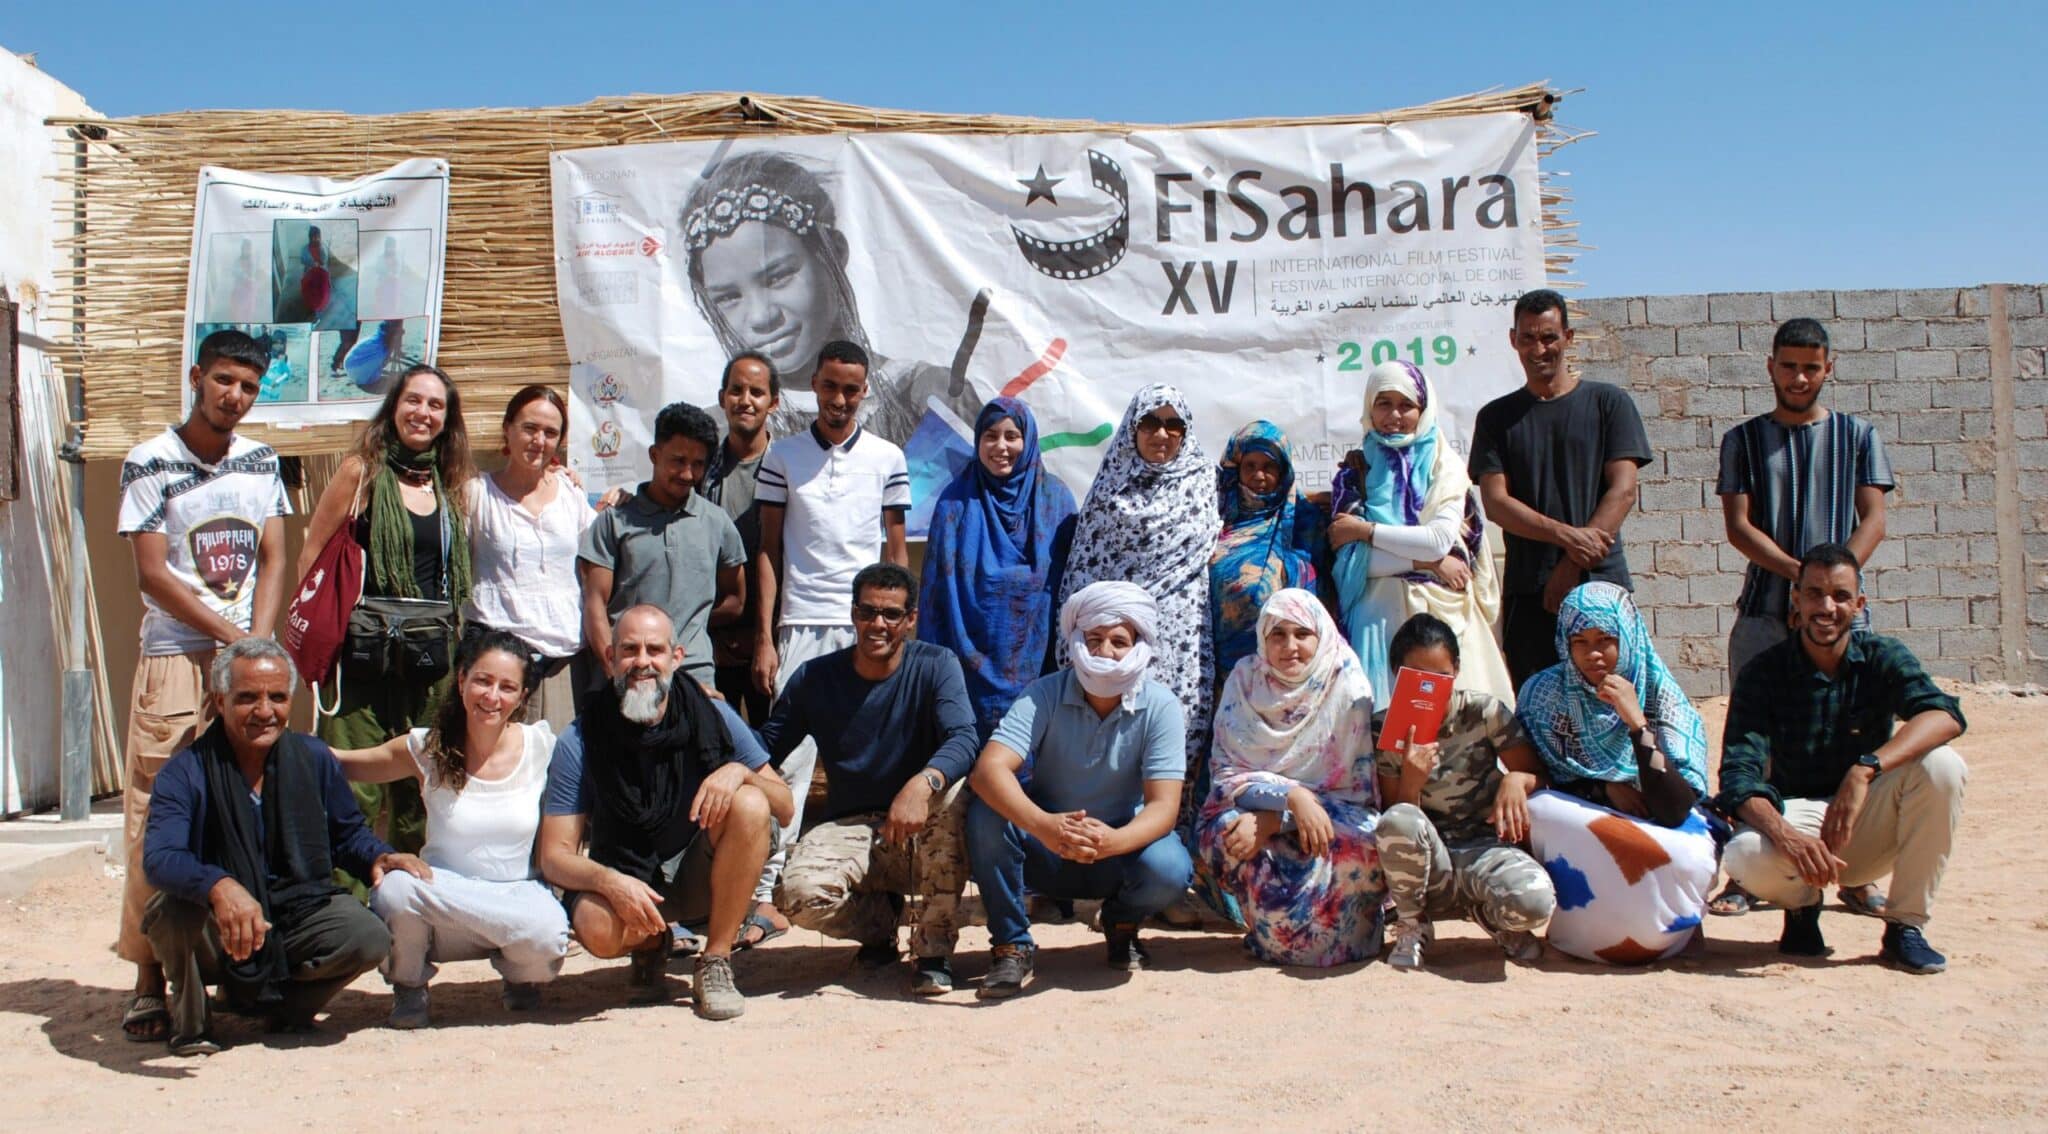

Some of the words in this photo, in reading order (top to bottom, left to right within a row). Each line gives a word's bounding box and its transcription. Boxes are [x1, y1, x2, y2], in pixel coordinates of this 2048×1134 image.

[1154, 163, 1519, 242] FiSahara
[1270, 252, 1401, 273] INTERNATIONAL
[1408, 251, 1443, 266] FILM
[1448, 247, 1521, 263] FESTIVAL
[1161, 260, 1238, 315] XV
[1271, 277, 1338, 293] FESTIVAL
[1342, 271, 1459, 288] INTERNACIONAL
[1465, 269, 1485, 281] DE
[1489, 267, 1523, 281] CINE
[1271, 299, 1312, 315] الغربية
[1319, 296, 1377, 313] بالصحراء
[1423, 290, 1465, 310] العالمي
[1337, 336, 1458, 371] 2019
[209, 553, 248, 573] 1978
